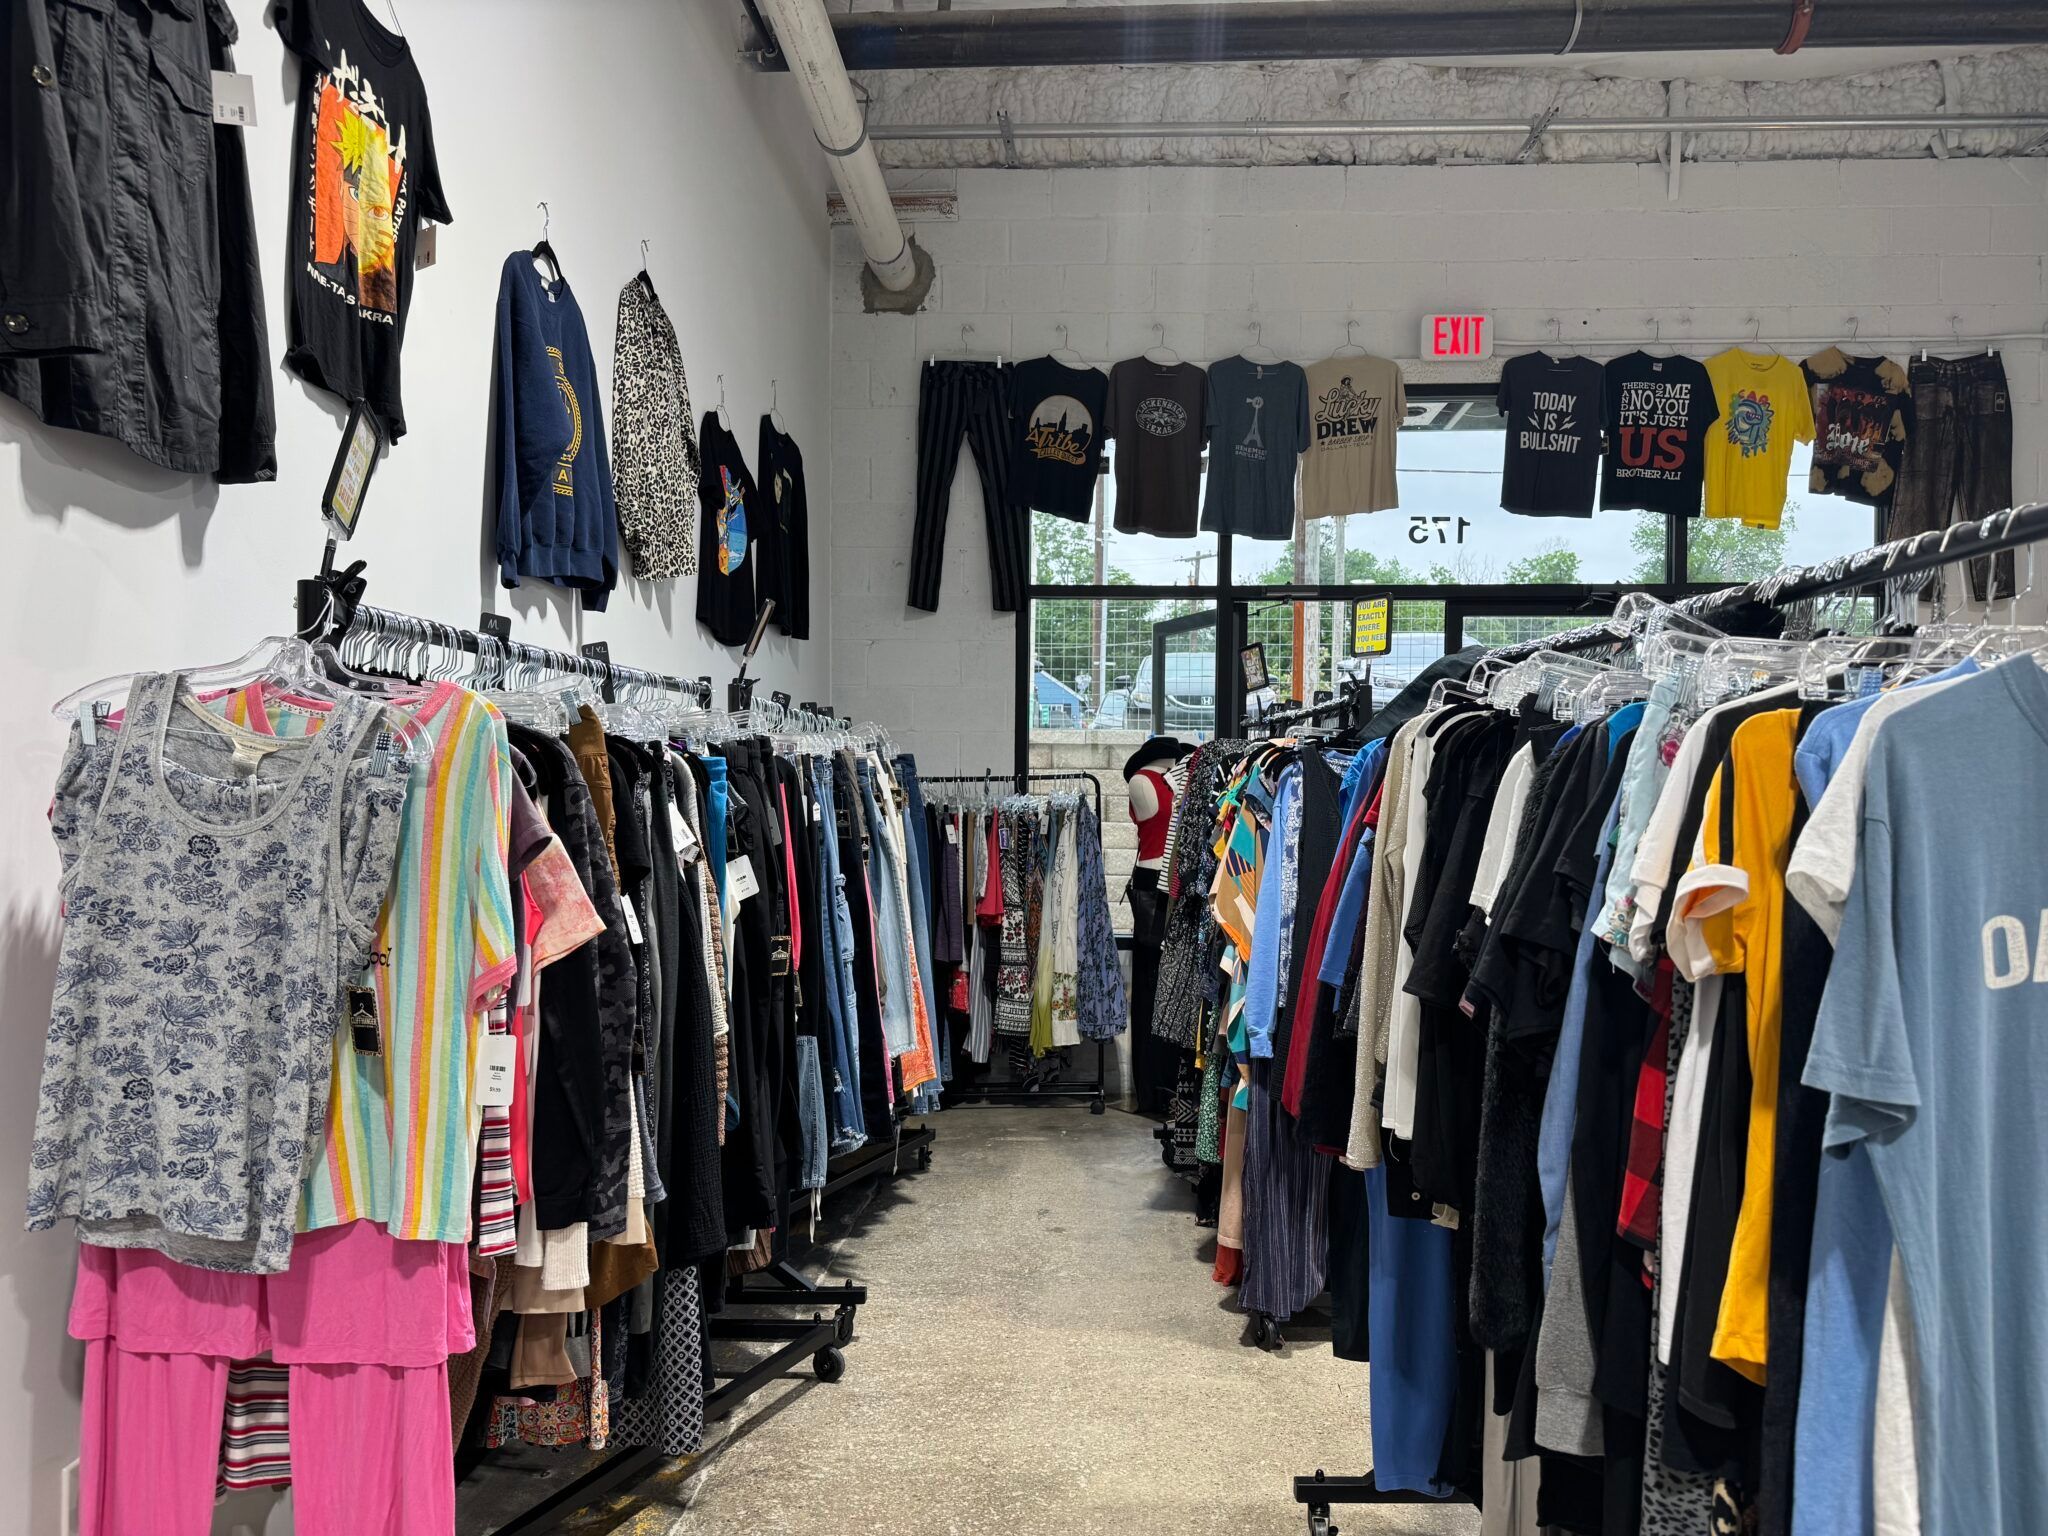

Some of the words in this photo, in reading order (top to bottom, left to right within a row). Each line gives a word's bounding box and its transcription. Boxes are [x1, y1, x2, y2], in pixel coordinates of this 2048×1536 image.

[1434, 316, 1484, 355] EXIT
[1621, 381, 1655, 390] THERE'S
[1665, 383, 1691, 399] ME
[1315, 387, 1381, 423] Lucky
[1533, 391, 1577, 413] TODAY
[1630, 389, 1654, 411] NO
[1655, 398, 1690, 416] YOU
[1145, 423, 1173, 434] TEXAS
[1317, 416, 1378, 440] DREW
[1543, 413, 1557, 431] IS
[1619, 411, 1648, 426] IT'S
[1649, 414, 1688, 428] JUST
[1520, 431, 1581, 454] BULLSHIT
[1619, 426, 1688, 470] US
[1616, 467, 1661, 479] BROTHER
[1662, 471, 1681, 481] ALI
[1358, 601, 1371, 610] YOU
[1373, 599, 1386, 608] ARE
[487, 618, 500, 631] M
[1358, 611, 1386, 621] EXACTLY
[1357, 622, 1380, 632] WHERE
[1357, 634, 1370, 643] YOU
